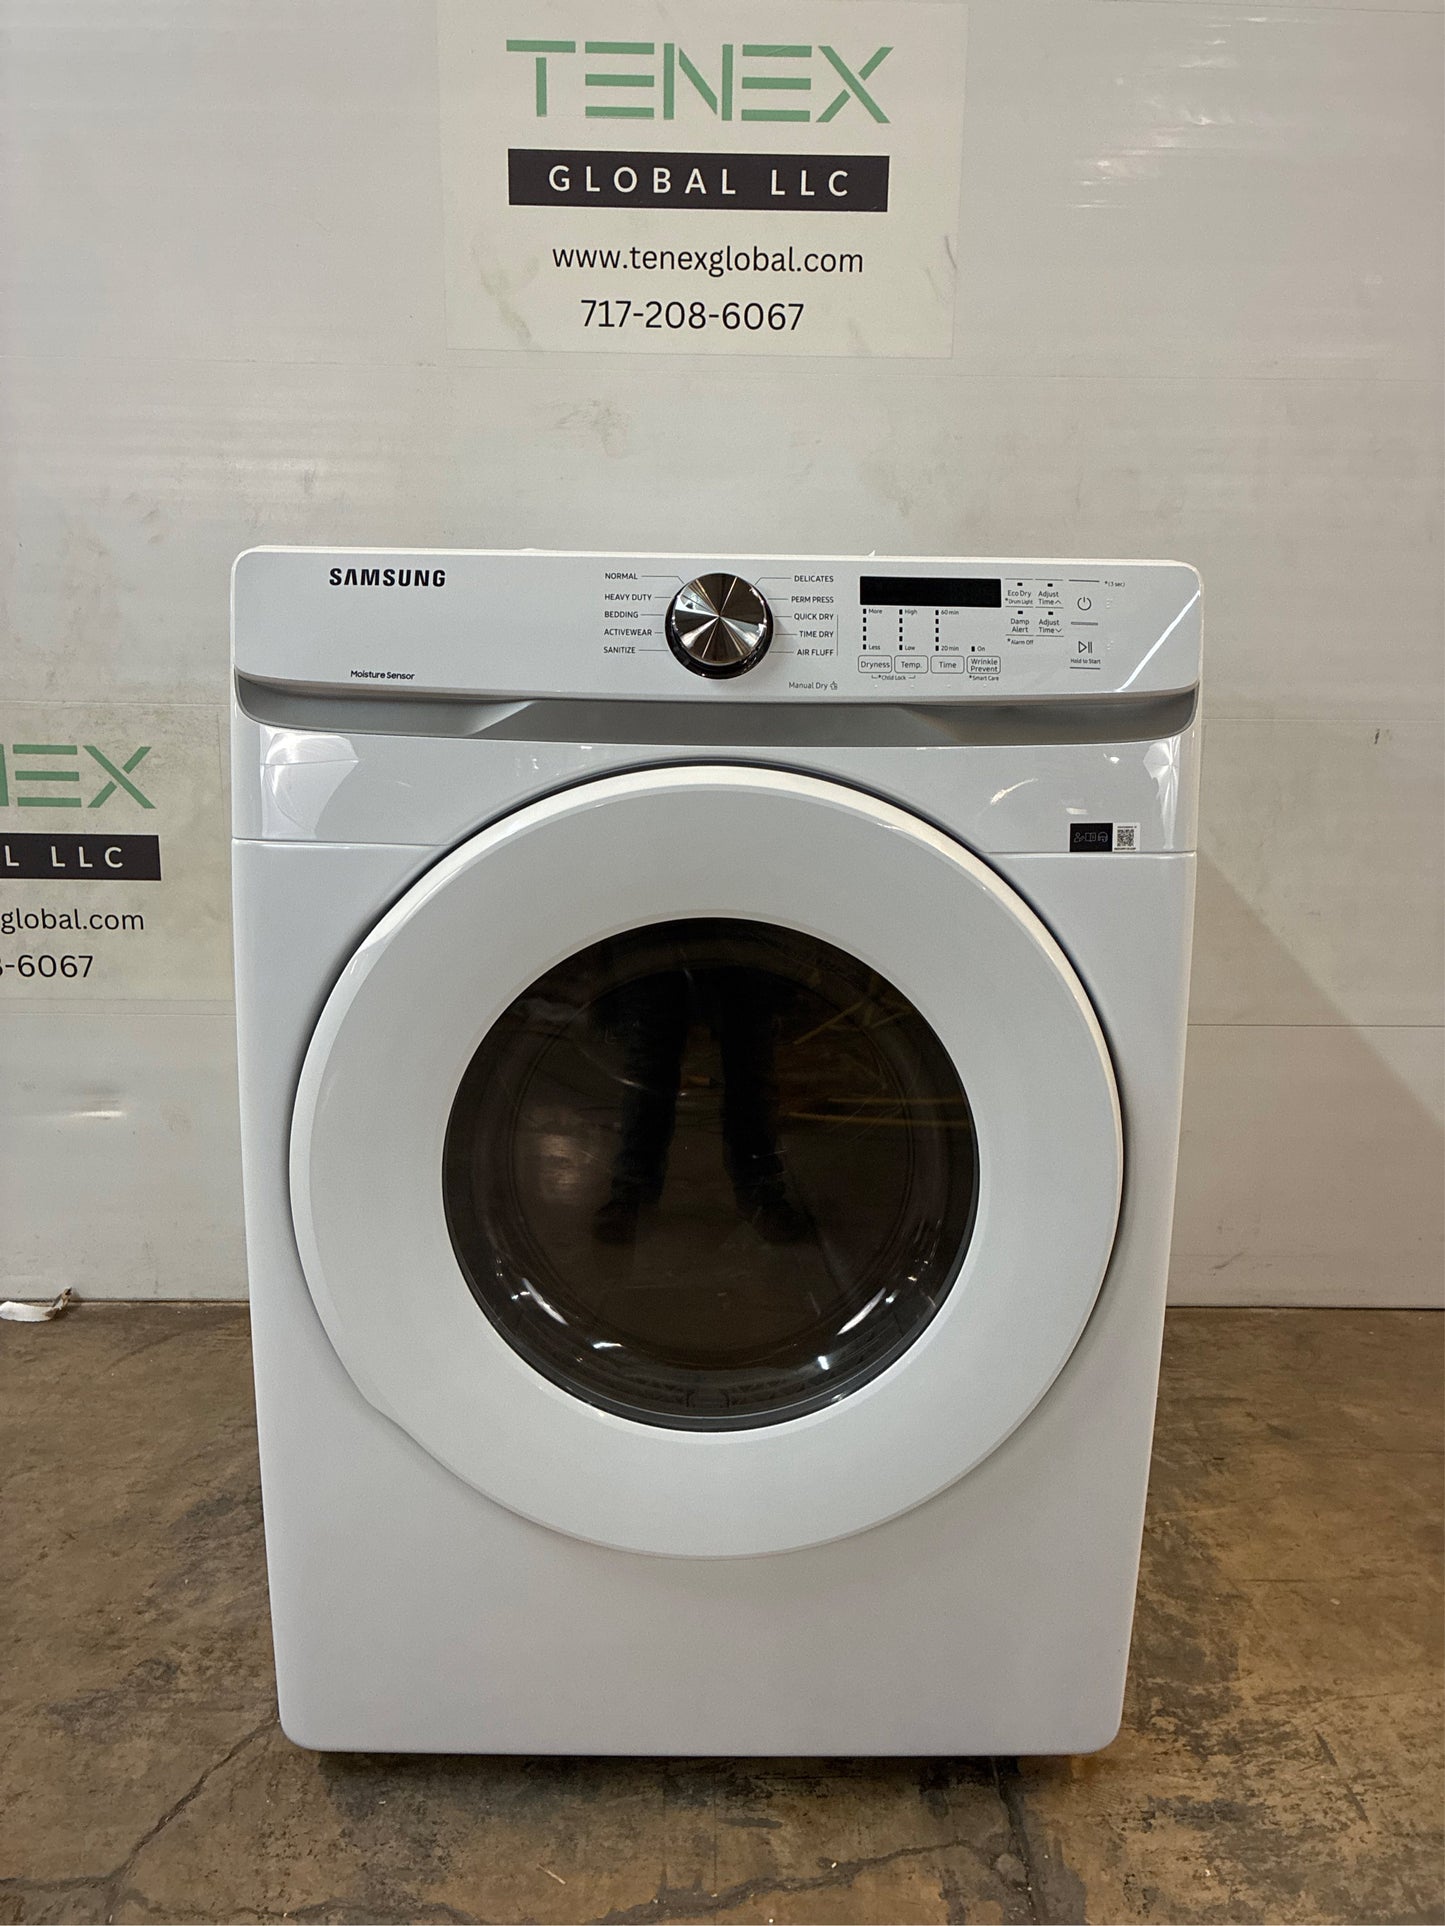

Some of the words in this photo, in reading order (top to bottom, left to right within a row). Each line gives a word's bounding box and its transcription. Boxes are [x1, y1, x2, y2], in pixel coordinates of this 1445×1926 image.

[506, 40, 894, 123] TENEX
[548, 165, 735, 195] GLOBAL
[771, 169, 849, 197] LLC
[552, 245, 864, 277] www.tenexglobal.com
[581, 299, 804, 331] 717-208-6067
[329, 568, 446, 587] SAMSUNG
[350, 670, 385, 679] Moisture
[387, 672, 415, 680] Sensor
[816, 682, 828, 690] Dry
[0, 744, 157, 809] EX
[51, 846, 123, 868] LLC
[1, 908, 144, 934] global.com
[0, 954, 94, 978] -6067
